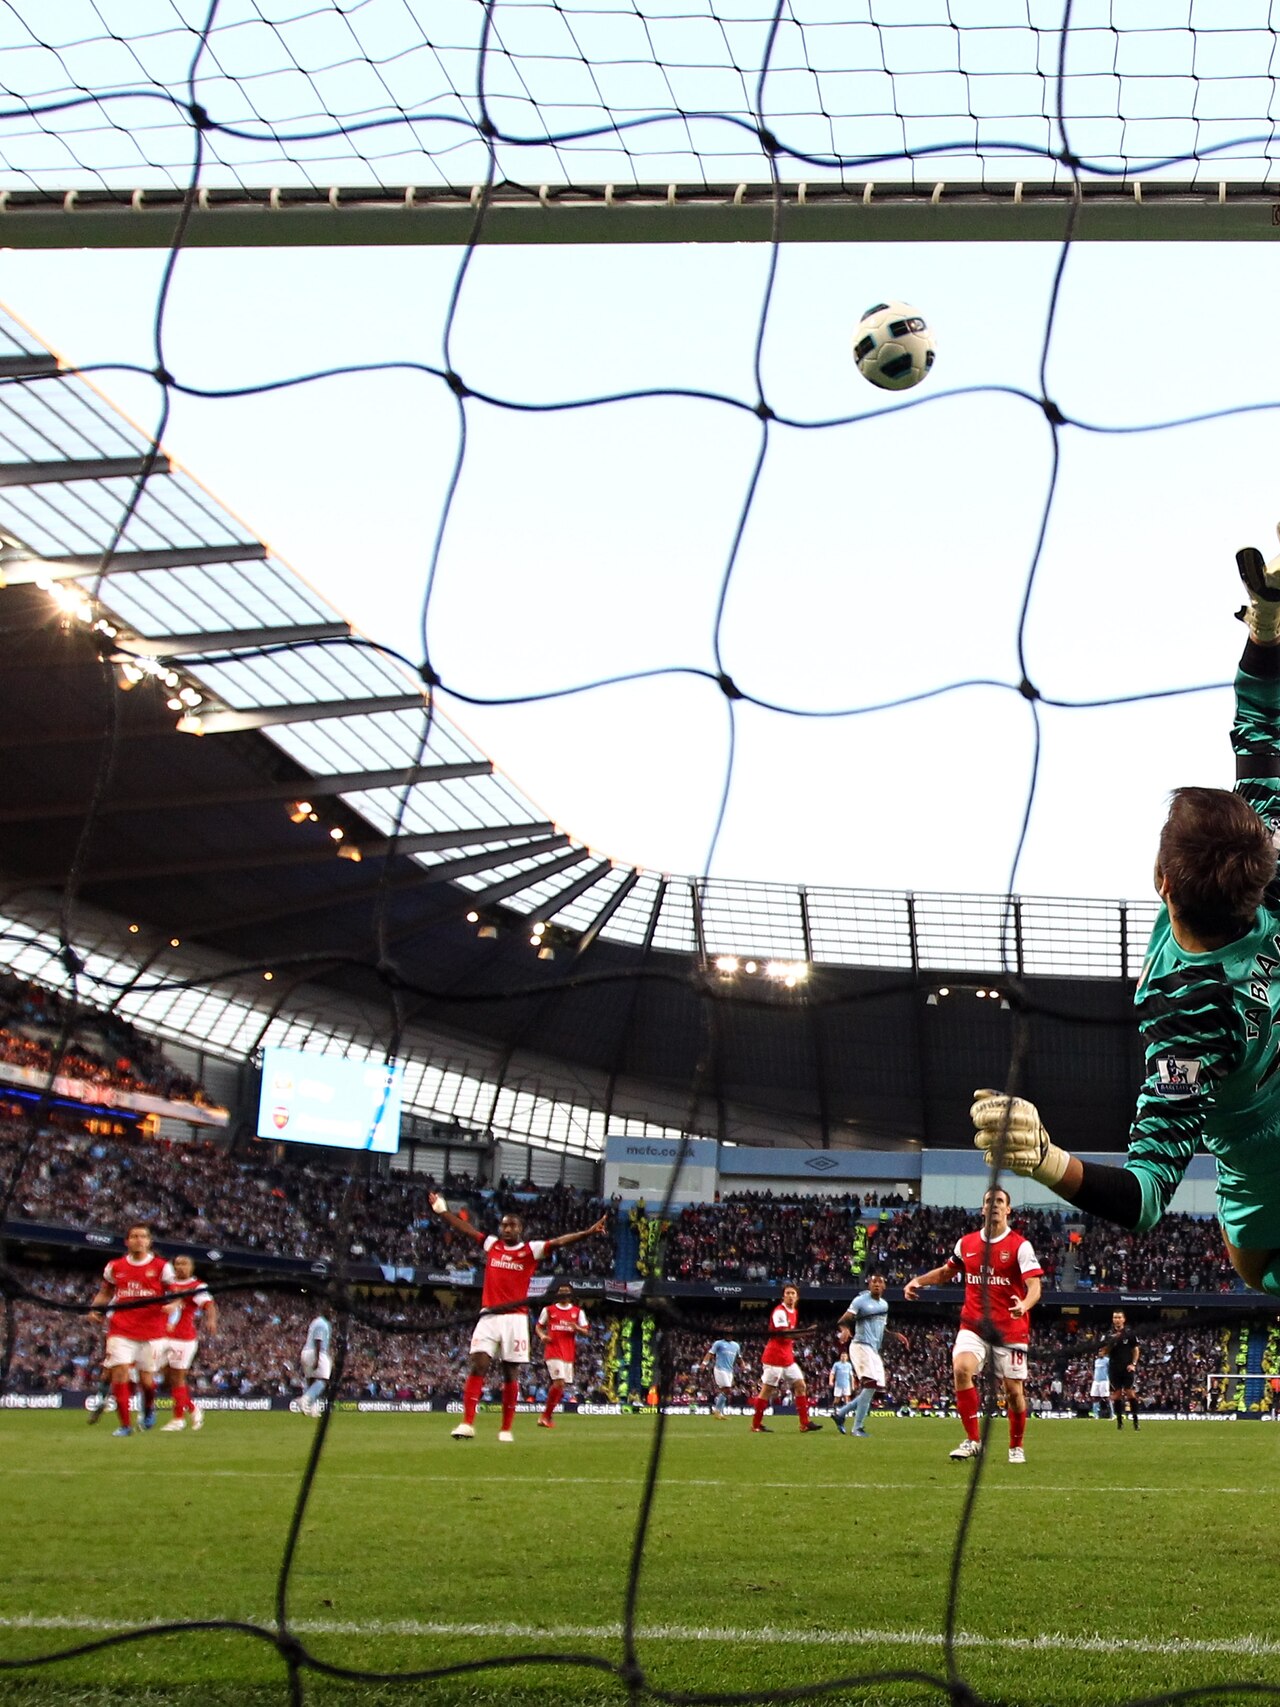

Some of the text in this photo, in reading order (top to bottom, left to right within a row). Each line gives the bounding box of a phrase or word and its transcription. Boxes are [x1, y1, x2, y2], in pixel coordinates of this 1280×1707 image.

[490, 1258, 524, 1271] Emirates
[513, 1340, 527, 1352] 20
[1010, 1350, 1023, 1366] 18
[27, 1394, 61, 1408] world
[245, 1398, 269, 1410] world
[577, 1404, 621, 1415] etisalat
